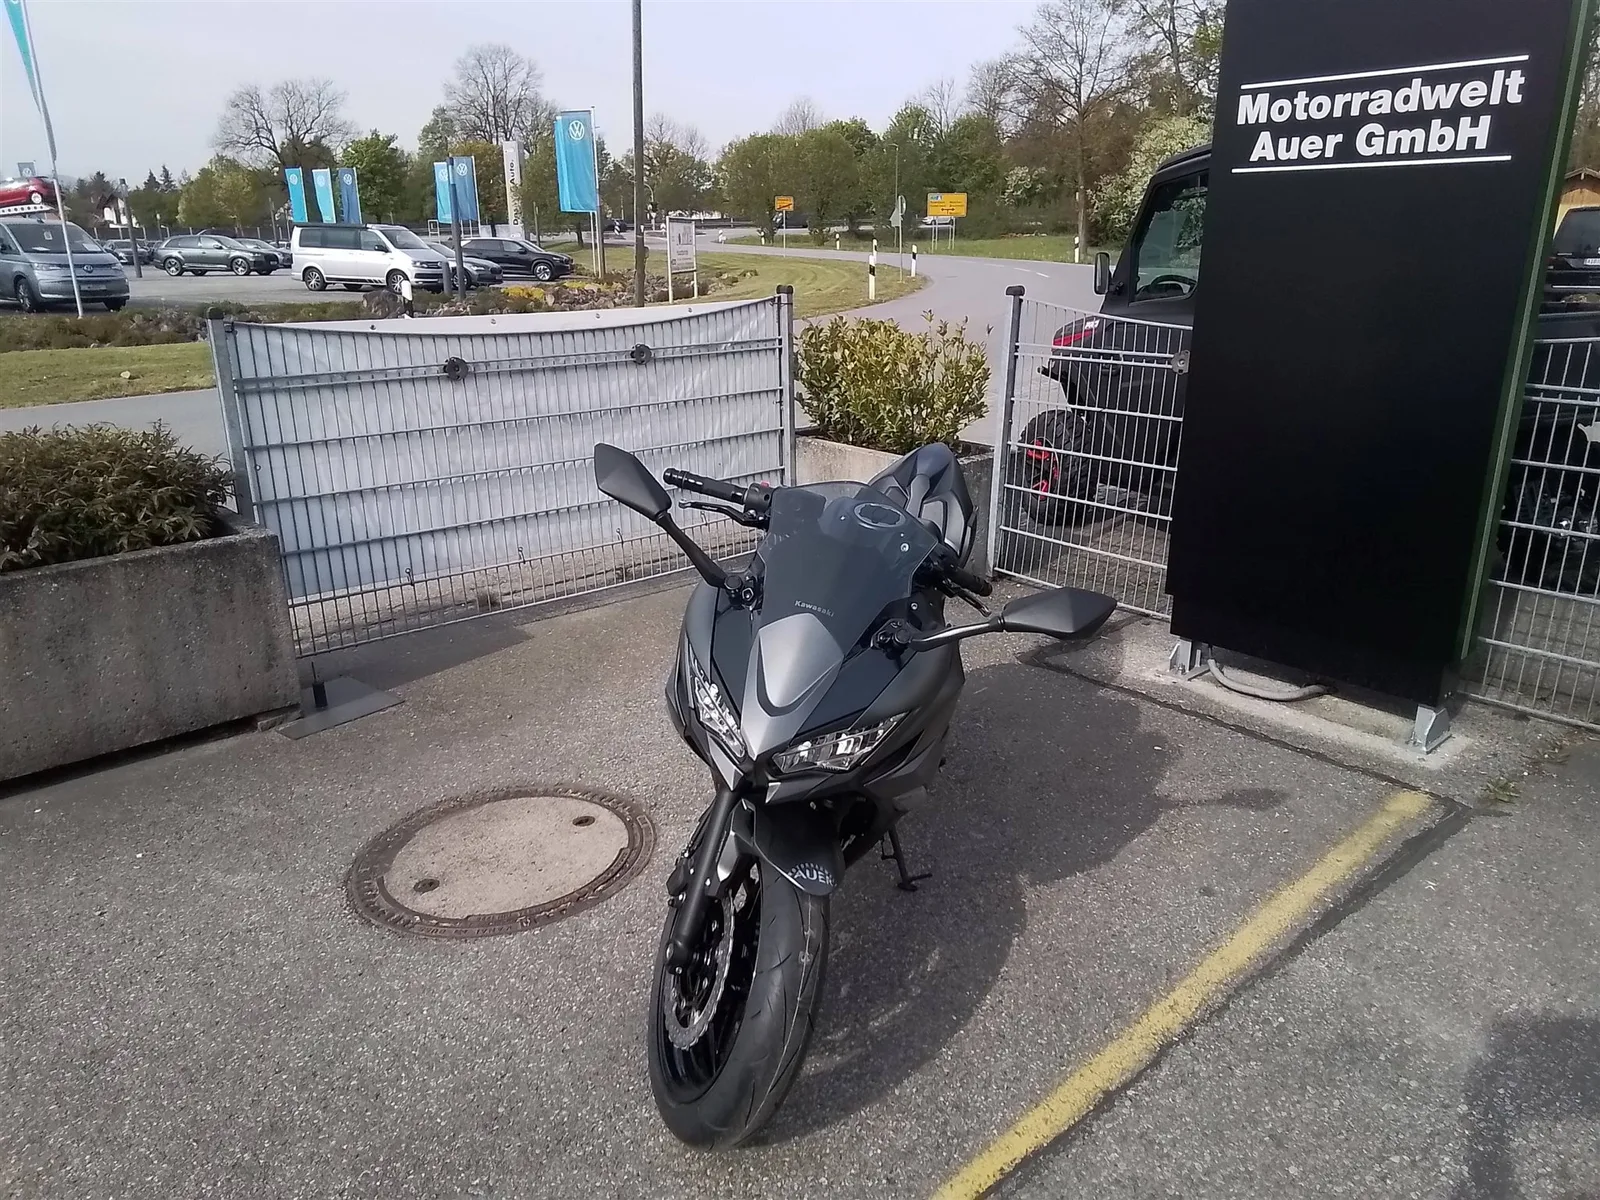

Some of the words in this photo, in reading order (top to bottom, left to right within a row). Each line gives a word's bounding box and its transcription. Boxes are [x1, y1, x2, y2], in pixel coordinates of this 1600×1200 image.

[1237, 69, 1525, 125] Motorradwelt
[1249, 130, 1343, 162] Auer
[1355, 114, 1492, 157] GmbH
[794, 600, 835, 617] Kawasaki
[794, 868, 834, 887] AUER
